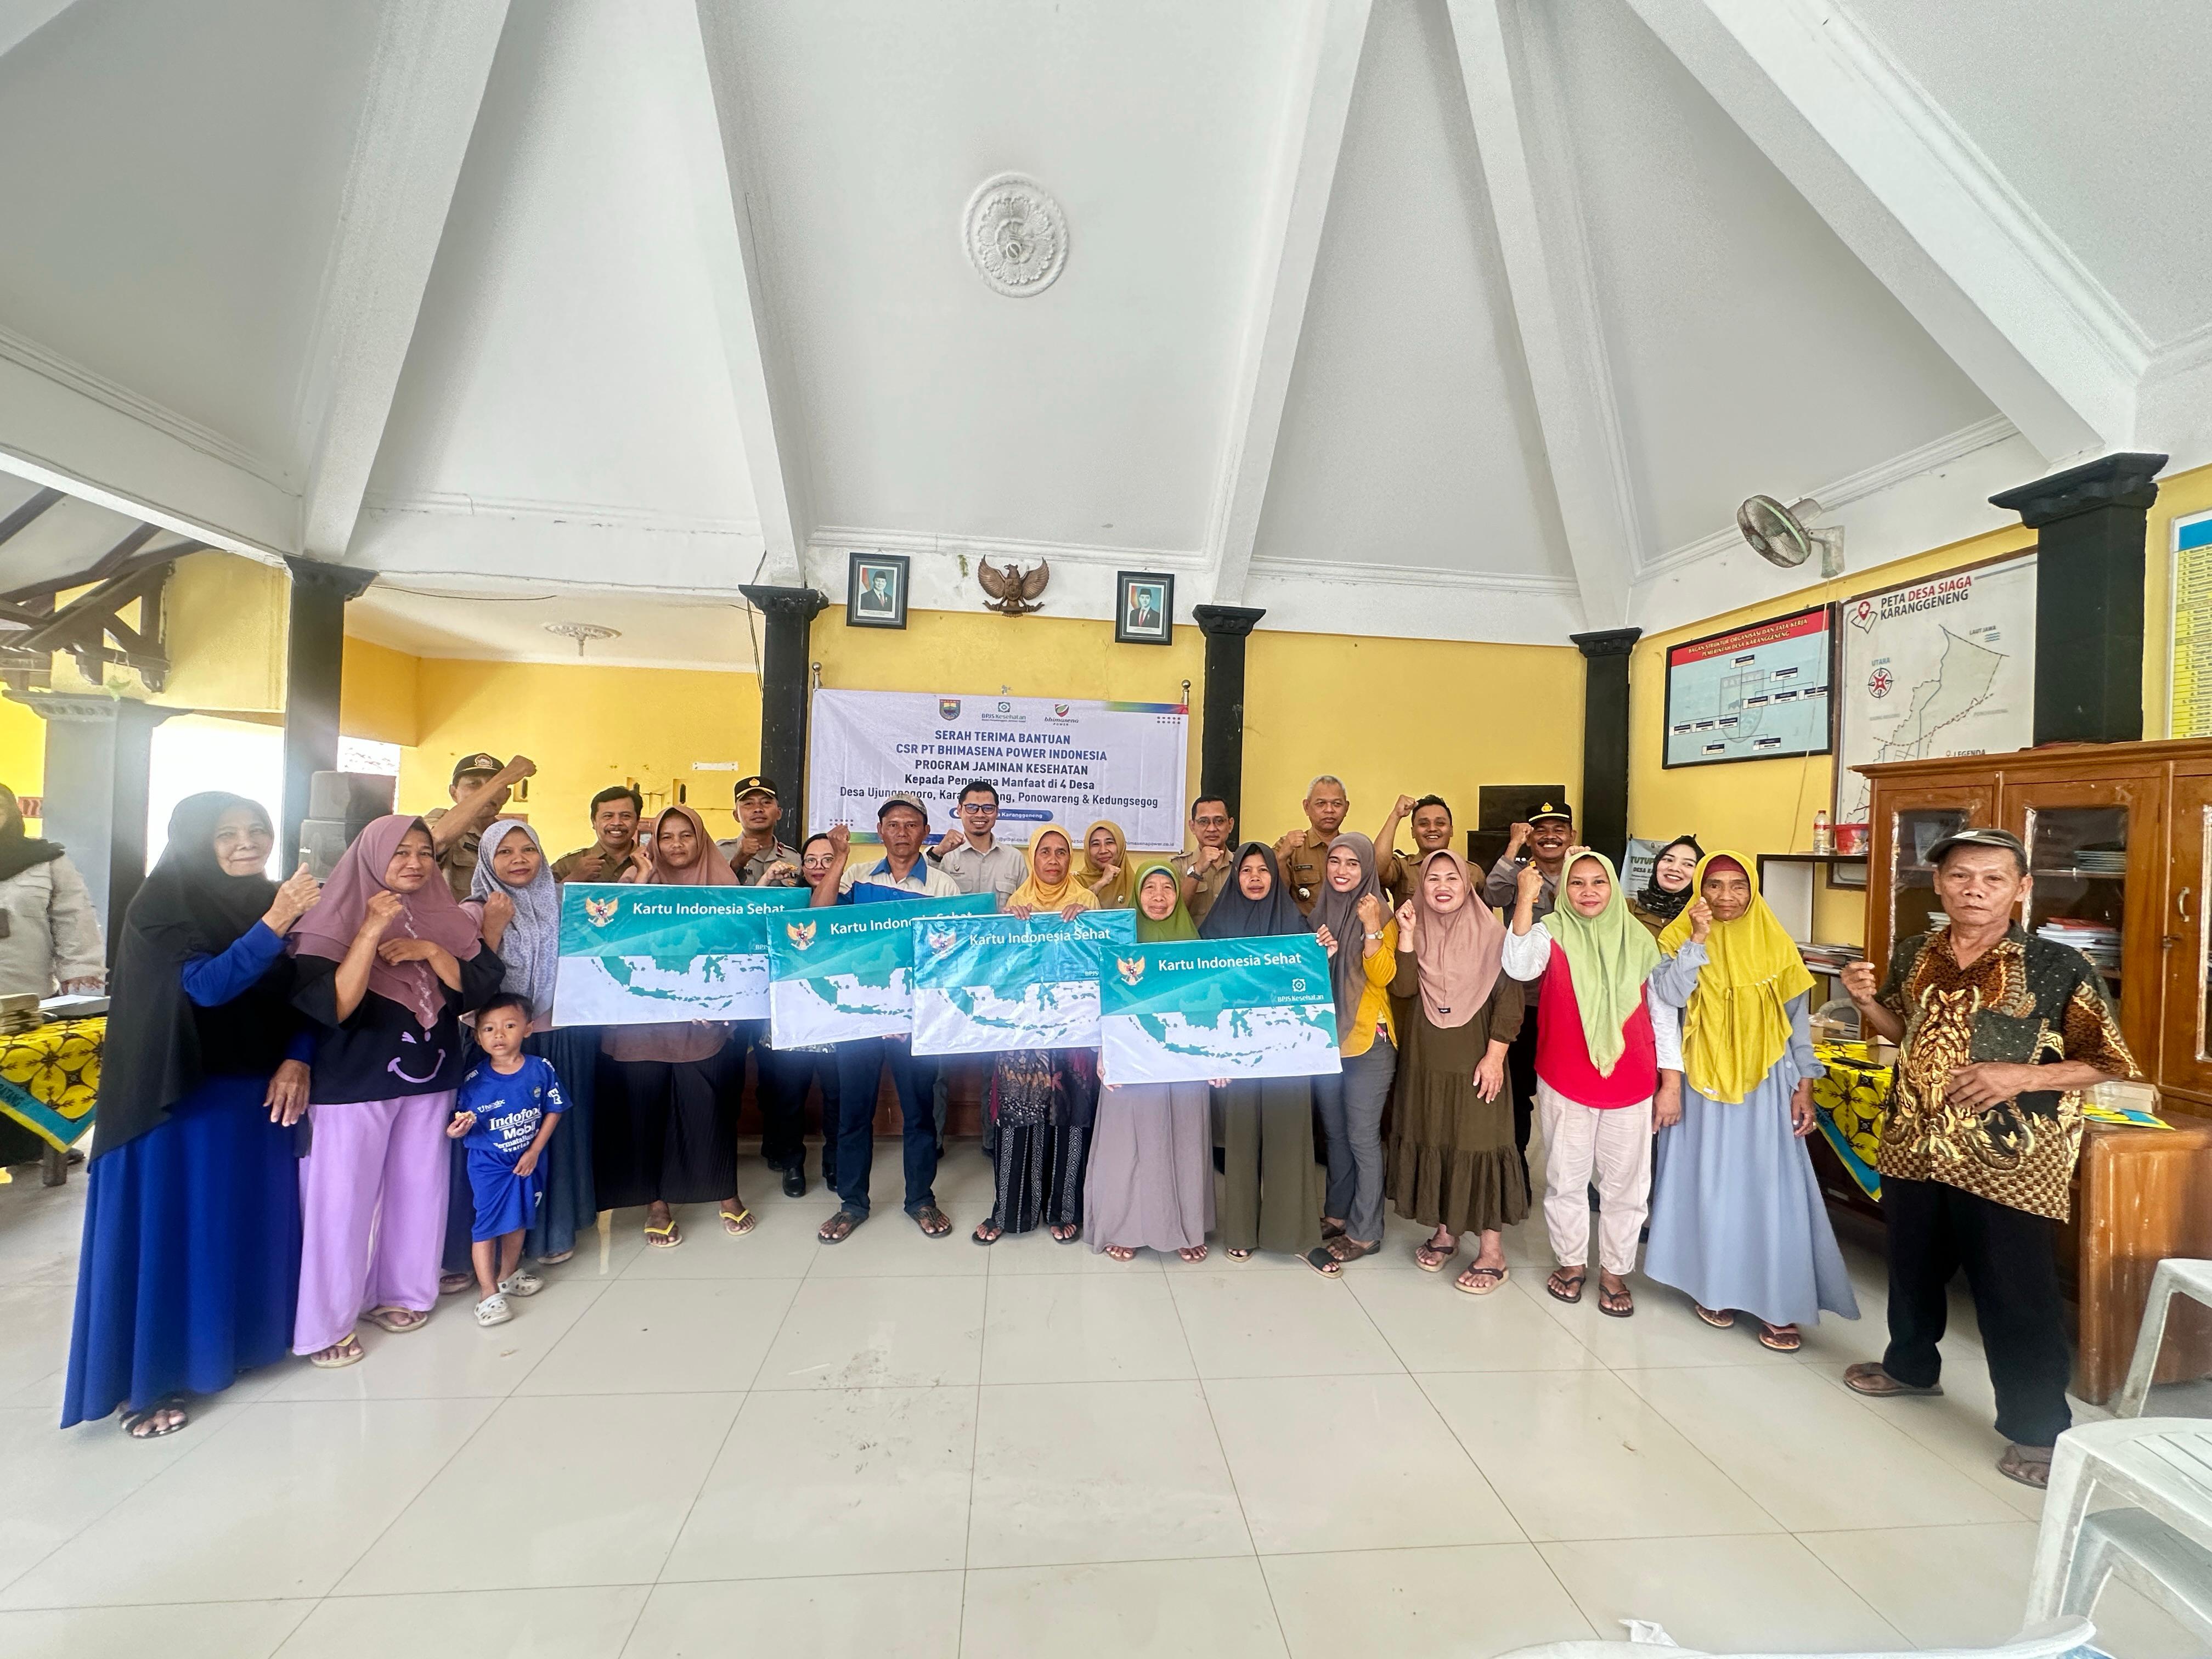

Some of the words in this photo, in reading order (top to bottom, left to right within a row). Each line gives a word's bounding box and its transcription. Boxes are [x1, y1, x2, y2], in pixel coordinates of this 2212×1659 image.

[1881, 593, 1905, 608] PETA
[1908, 586, 1936, 602] DESA
[1938, 576, 1972, 594] SIAGA
[1880, 589, 1969, 620] KARANGGENENG
[1689, 644, 1705, 653] BAGAN
[1705, 638, 1729, 650] STRUKTUR
[1730, 631, 1761, 643] ORGANISASI
[1776, 623, 1789, 631] TATA
[1790, 618, 1808, 628] KERJA
[1702, 645, 1731, 657] PEMERINTAH
[1731, 641, 1745, 650] DESA
[1745, 631, 1791, 646] KARANGGENENG
[1871, 657, 1891, 667] UTARA
[935, 730, 971, 742] SERAH
[975, 731, 1016, 743] TERIMA
[1019, 732, 1070, 744] BANTUAN
[896, 743, 918, 755] CSR
[921, 744, 934, 755] PT
[938, 745, 1003, 757] BHIMASENA
[1006, 747, 1046, 759] POWER
[1048, 749, 1108, 761] INDONESIA
[1954, 749, 1986, 757] LEGENDA
[915, 759, 969, 771] PROGRAM
[972, 761, 1023, 772] JAMINAN
[1026, 763, 1088, 775] KESEHATAN
[905, 774, 944, 786] Kepada
[1002, 777, 1046, 788] Manfaat
[1048, 778, 1058, 788] di
[1060, 779, 1066, 789] 4
[1069, 780, 1095, 790] Desa
[840, 787, 865, 797] Desa
[1018, 792, 1079, 805] Ponowareng
[1082, 795, 1090, 804] &
[1092, 794, 1158, 809] Kedungsegog
[633, 902, 672, 916] Kartu
[676, 902, 743, 915] Indonesia
[747, 903, 785, 915] Sehat
[830, 923, 867, 935] Kartu
[970, 933, 1005, 945] Kartu
[1009, 932, 1071, 944] Indonesia
[1074, 928, 1111, 940] Sehat
[1159, 959, 1194, 972] Kartu
[1197, 956, 1260, 969] Indonesia
[1264, 952, 1302, 966] Sehat
